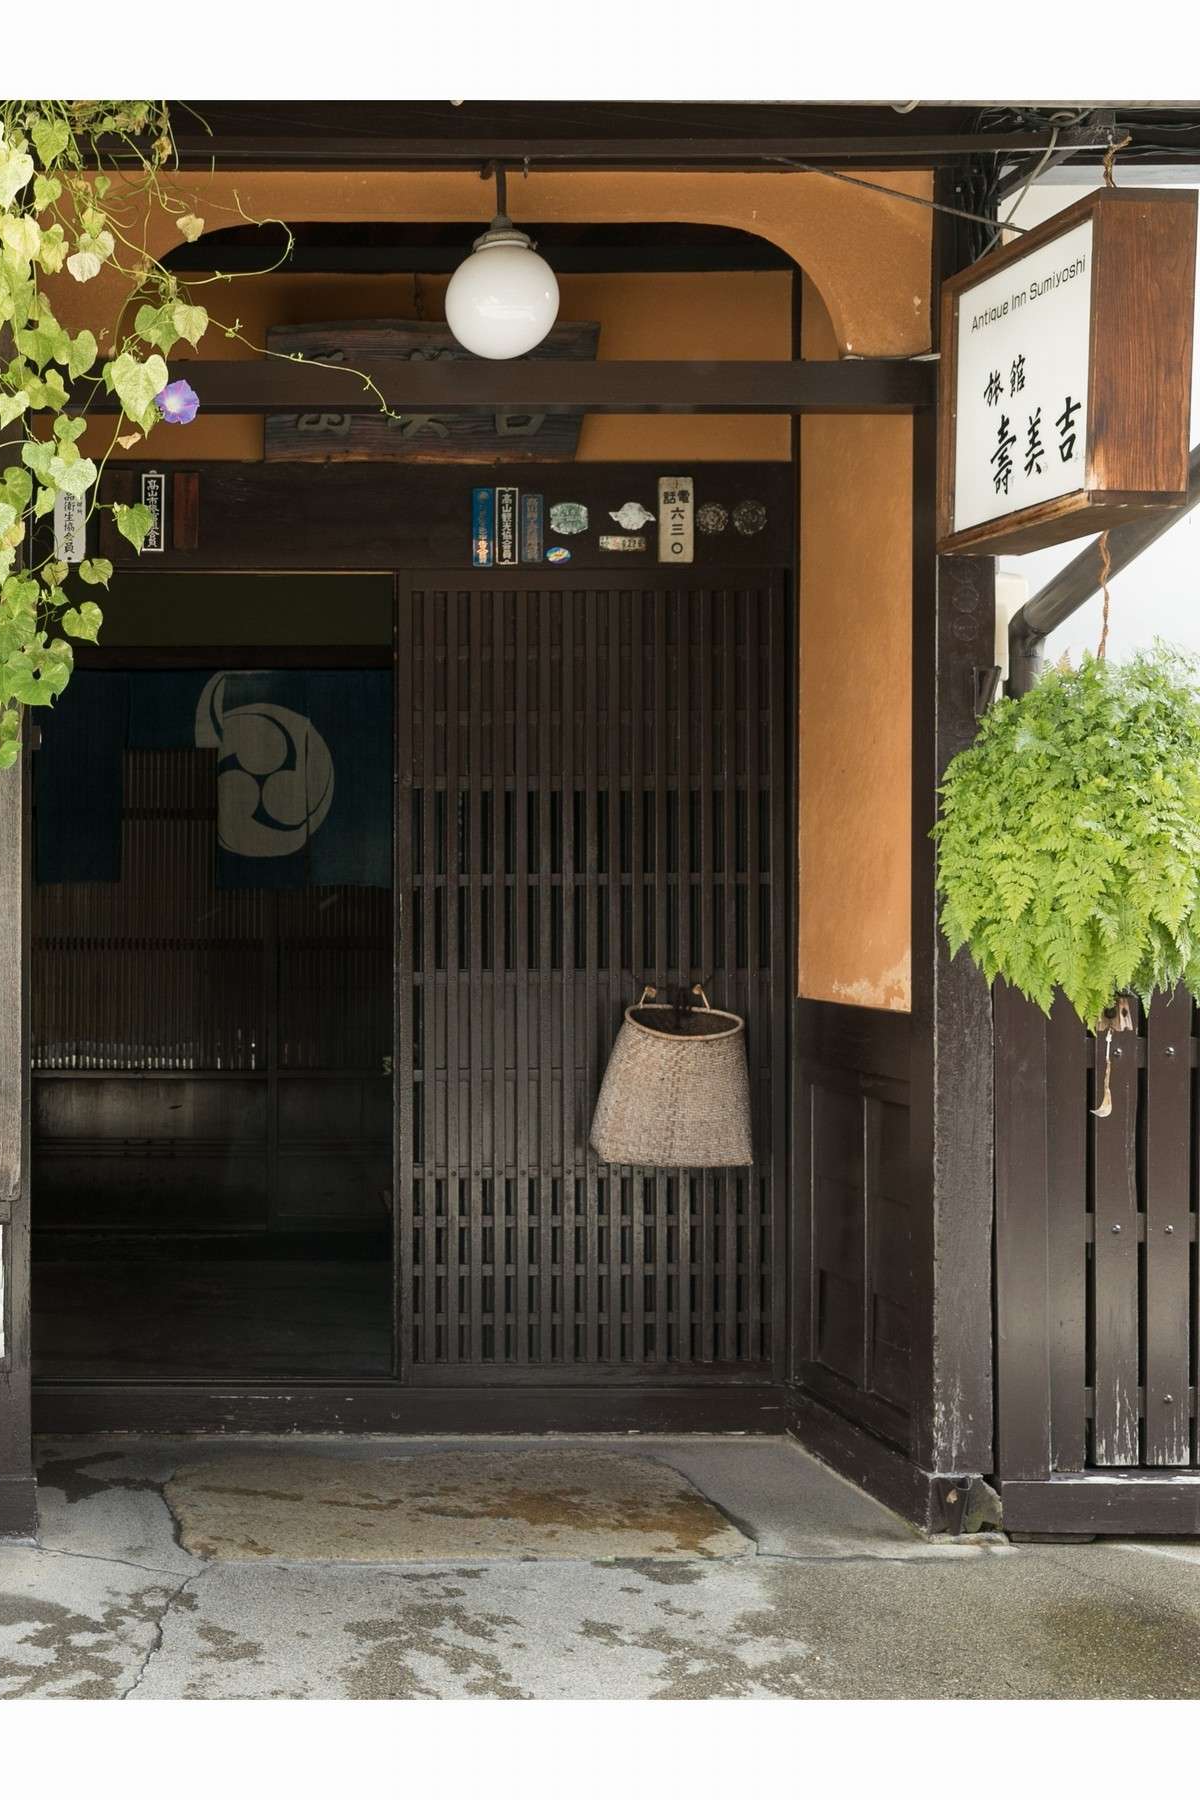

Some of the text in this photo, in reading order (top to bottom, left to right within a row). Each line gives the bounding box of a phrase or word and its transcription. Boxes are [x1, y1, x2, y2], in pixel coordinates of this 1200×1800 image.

[971, 254, 1086, 333] Antique Inn Sumiyoshi
